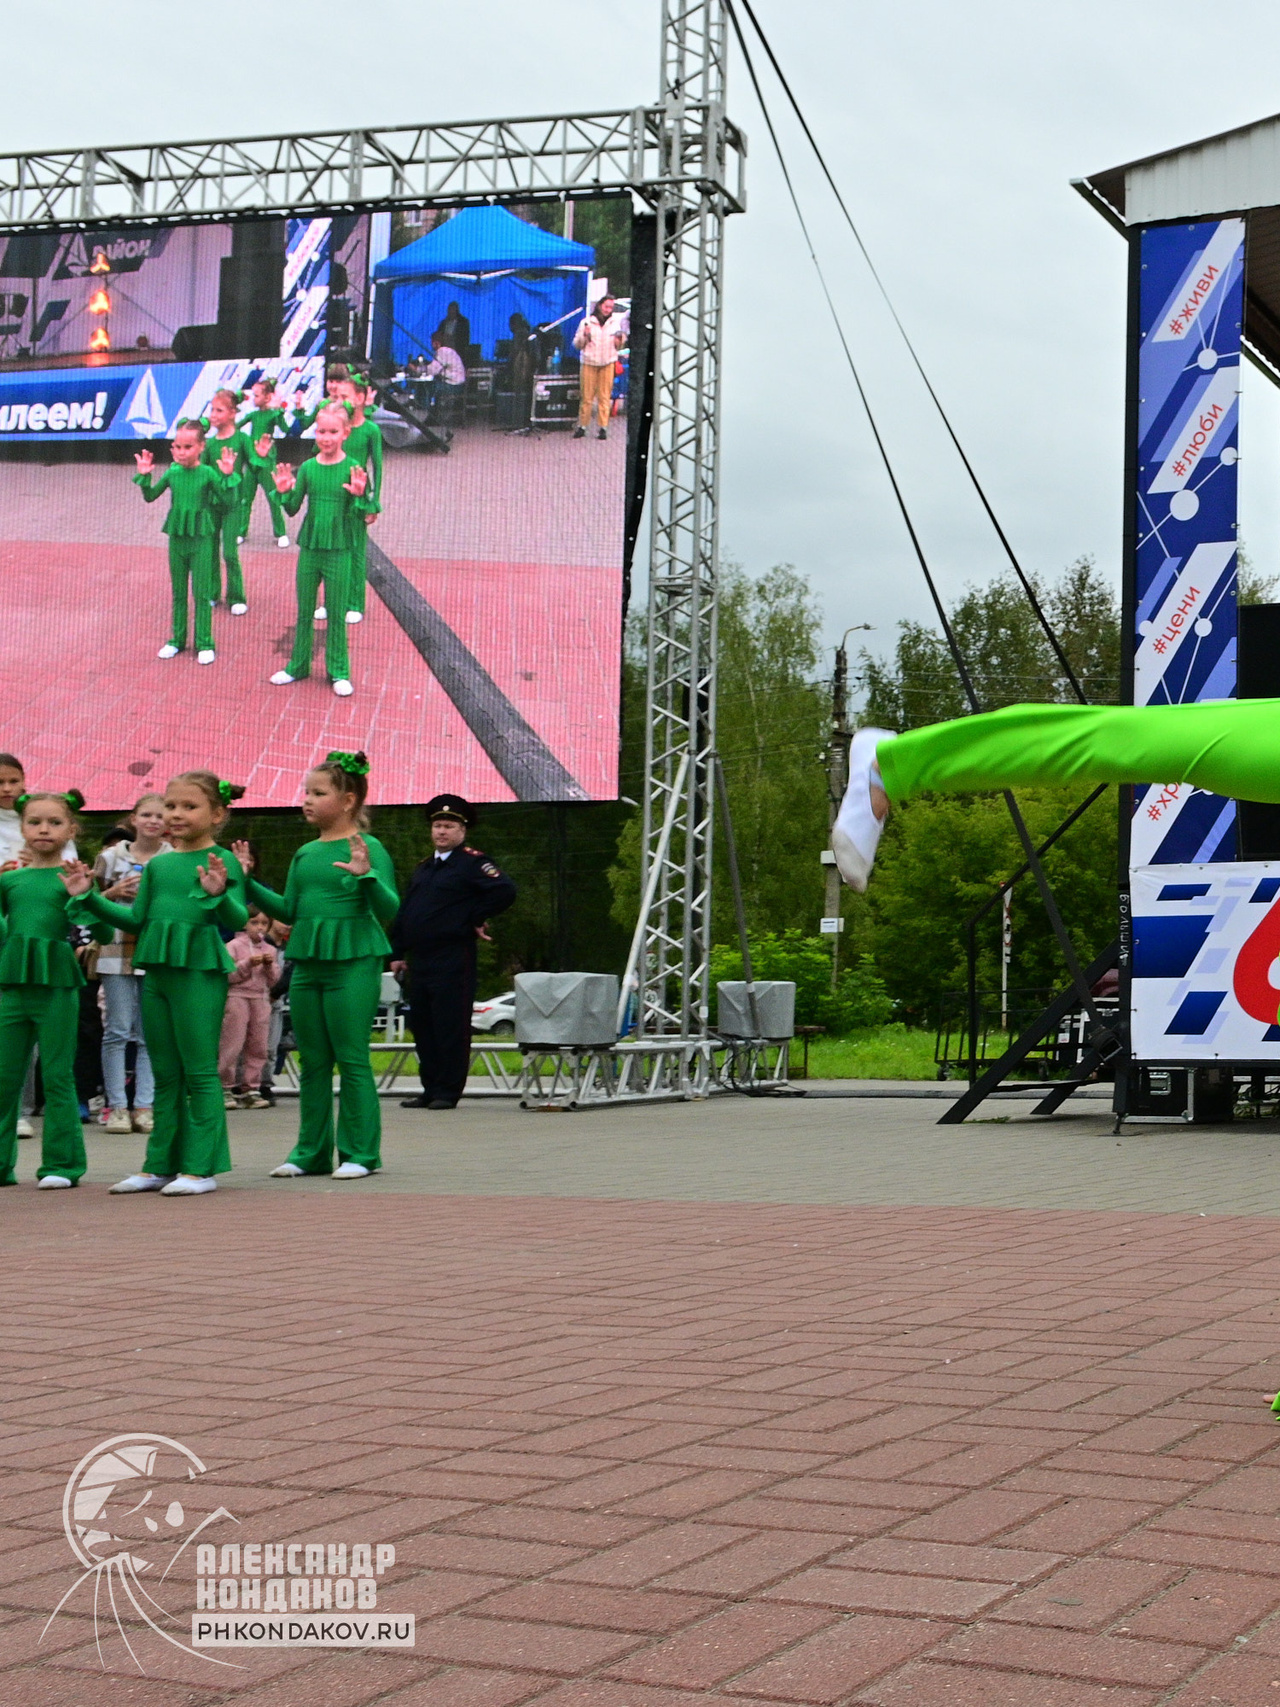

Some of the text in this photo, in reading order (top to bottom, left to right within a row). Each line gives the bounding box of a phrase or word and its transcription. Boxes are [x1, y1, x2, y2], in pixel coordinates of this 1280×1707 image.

[1169, 264, 1219, 335] #живи
[1172, 403, 1223, 477] #люби
[1153, 586, 1201, 655] #цени
